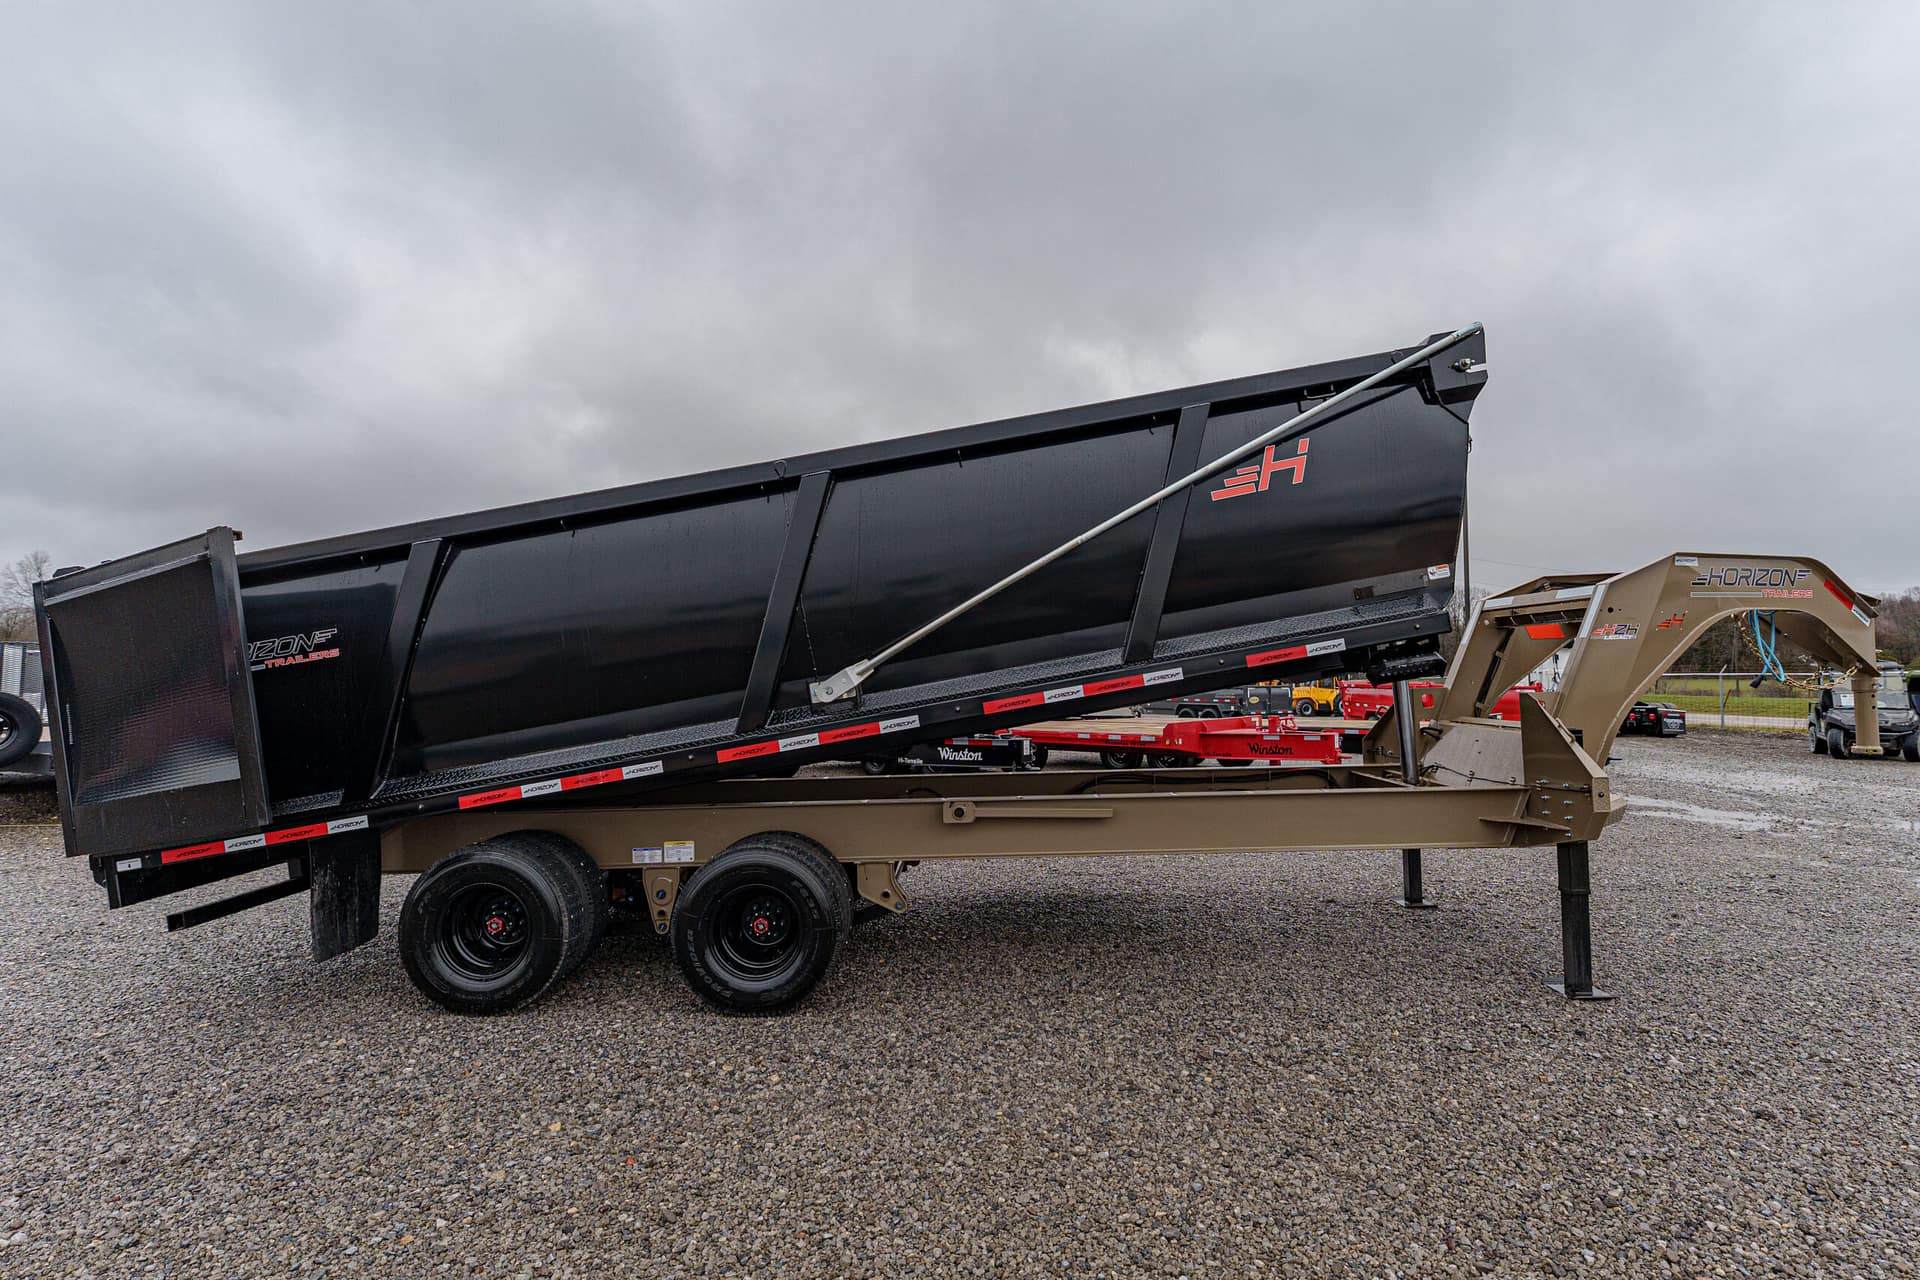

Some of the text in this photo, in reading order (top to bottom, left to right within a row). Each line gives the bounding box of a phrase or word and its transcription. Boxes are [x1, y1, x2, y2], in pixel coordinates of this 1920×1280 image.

[1706, 566, 1802, 588] HORIZON
[1762, 589, 1814, 600] TRAILERS
[264, 648, 340, 669] TRAILERS
[937, 746, 983, 761] Winston
[1248, 742, 1294, 756] Winston
